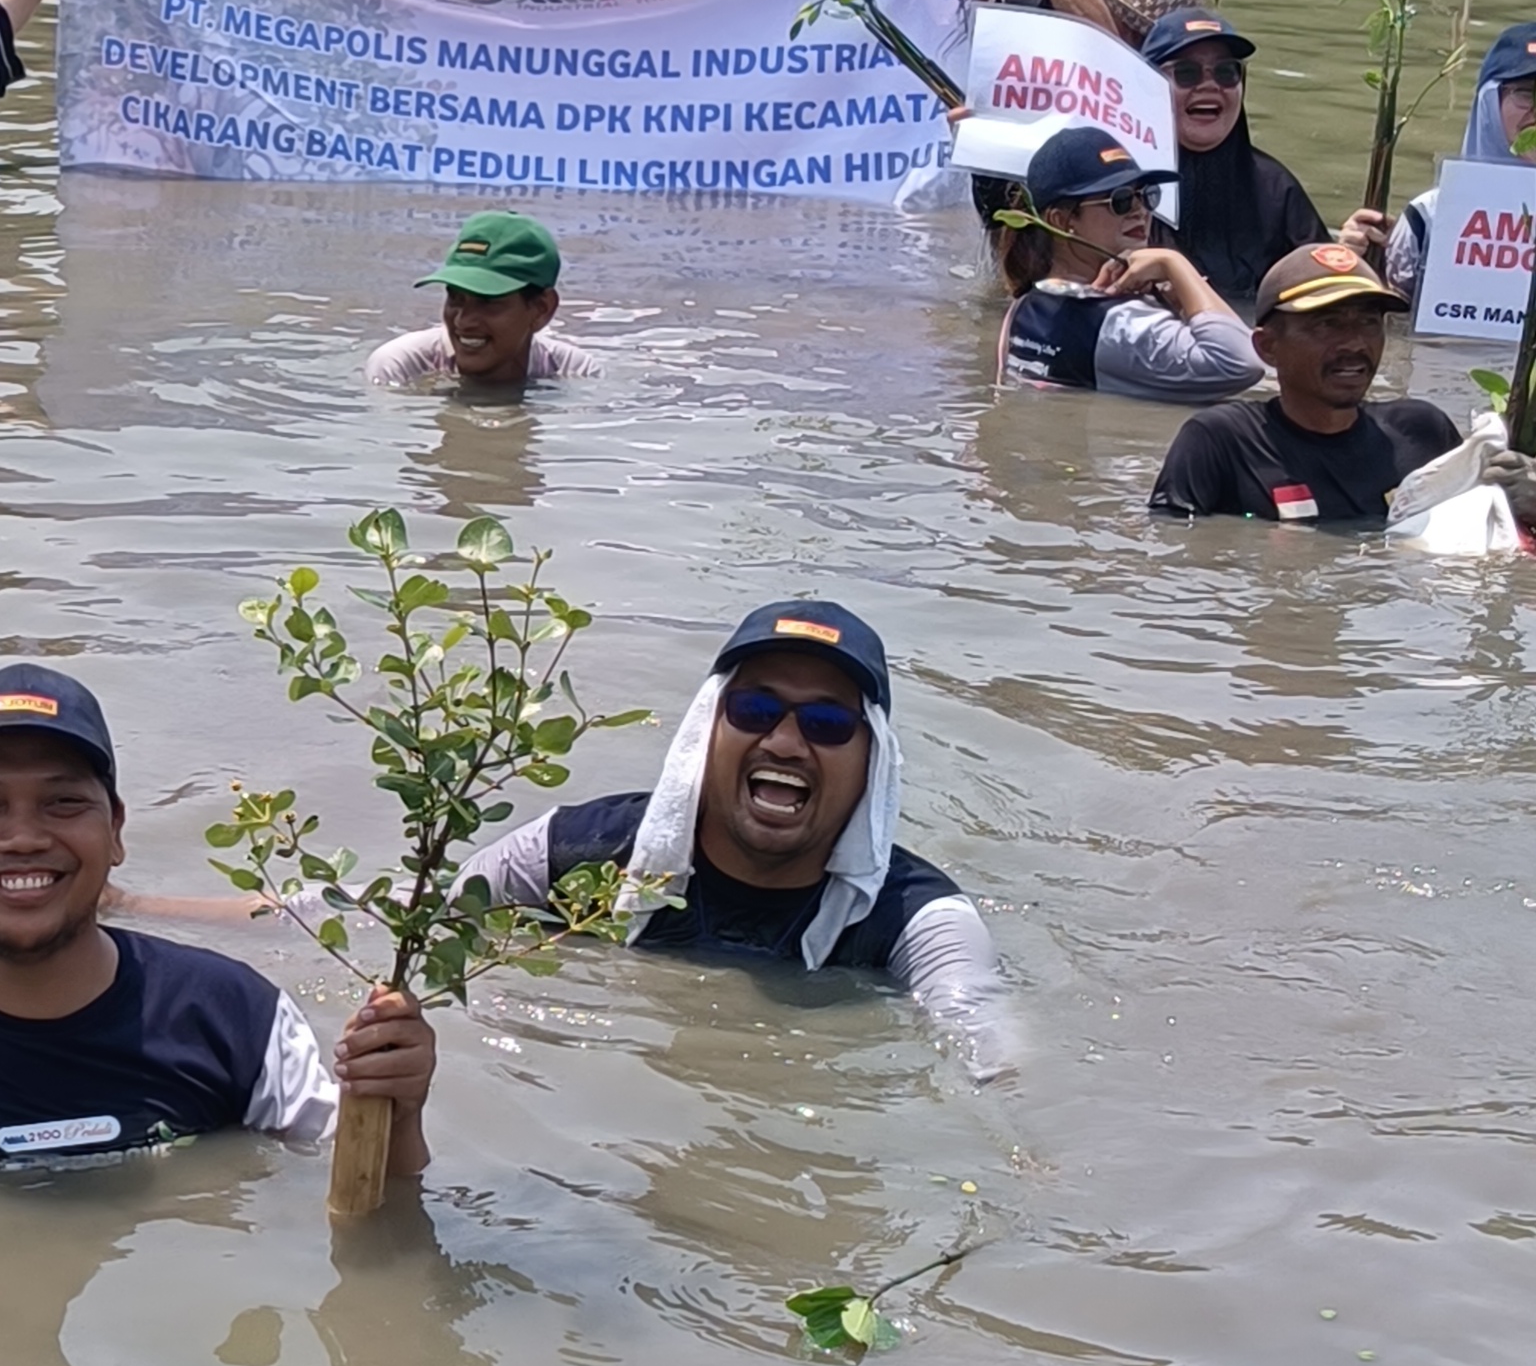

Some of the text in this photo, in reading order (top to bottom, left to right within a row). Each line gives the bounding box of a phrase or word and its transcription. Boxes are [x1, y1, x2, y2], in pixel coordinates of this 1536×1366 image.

[222, 5, 427, 65] MEGAPOLIS
[437, 39, 681, 79] MANUNGGAL
[692, 42, 905, 78] INDUSTRIA
[103, 37, 360, 110] DEVELOPMENT
[369, 85, 545, 130] BERSAMA
[556, 103, 632, 134] DPK
[643, 102, 732, 134] KNPI
[995, 54, 1124, 106] AM/NS
[121, 95, 296, 155] CIKARANG
[305, 129, 424, 172] BARAT
[432, 146, 566, 184] PEDULI
[578, 153, 832, 191] LINGKUNGAN
[992, 83, 1158, 151] INDONESIA
[1434, 302, 1478, 321] CSR
